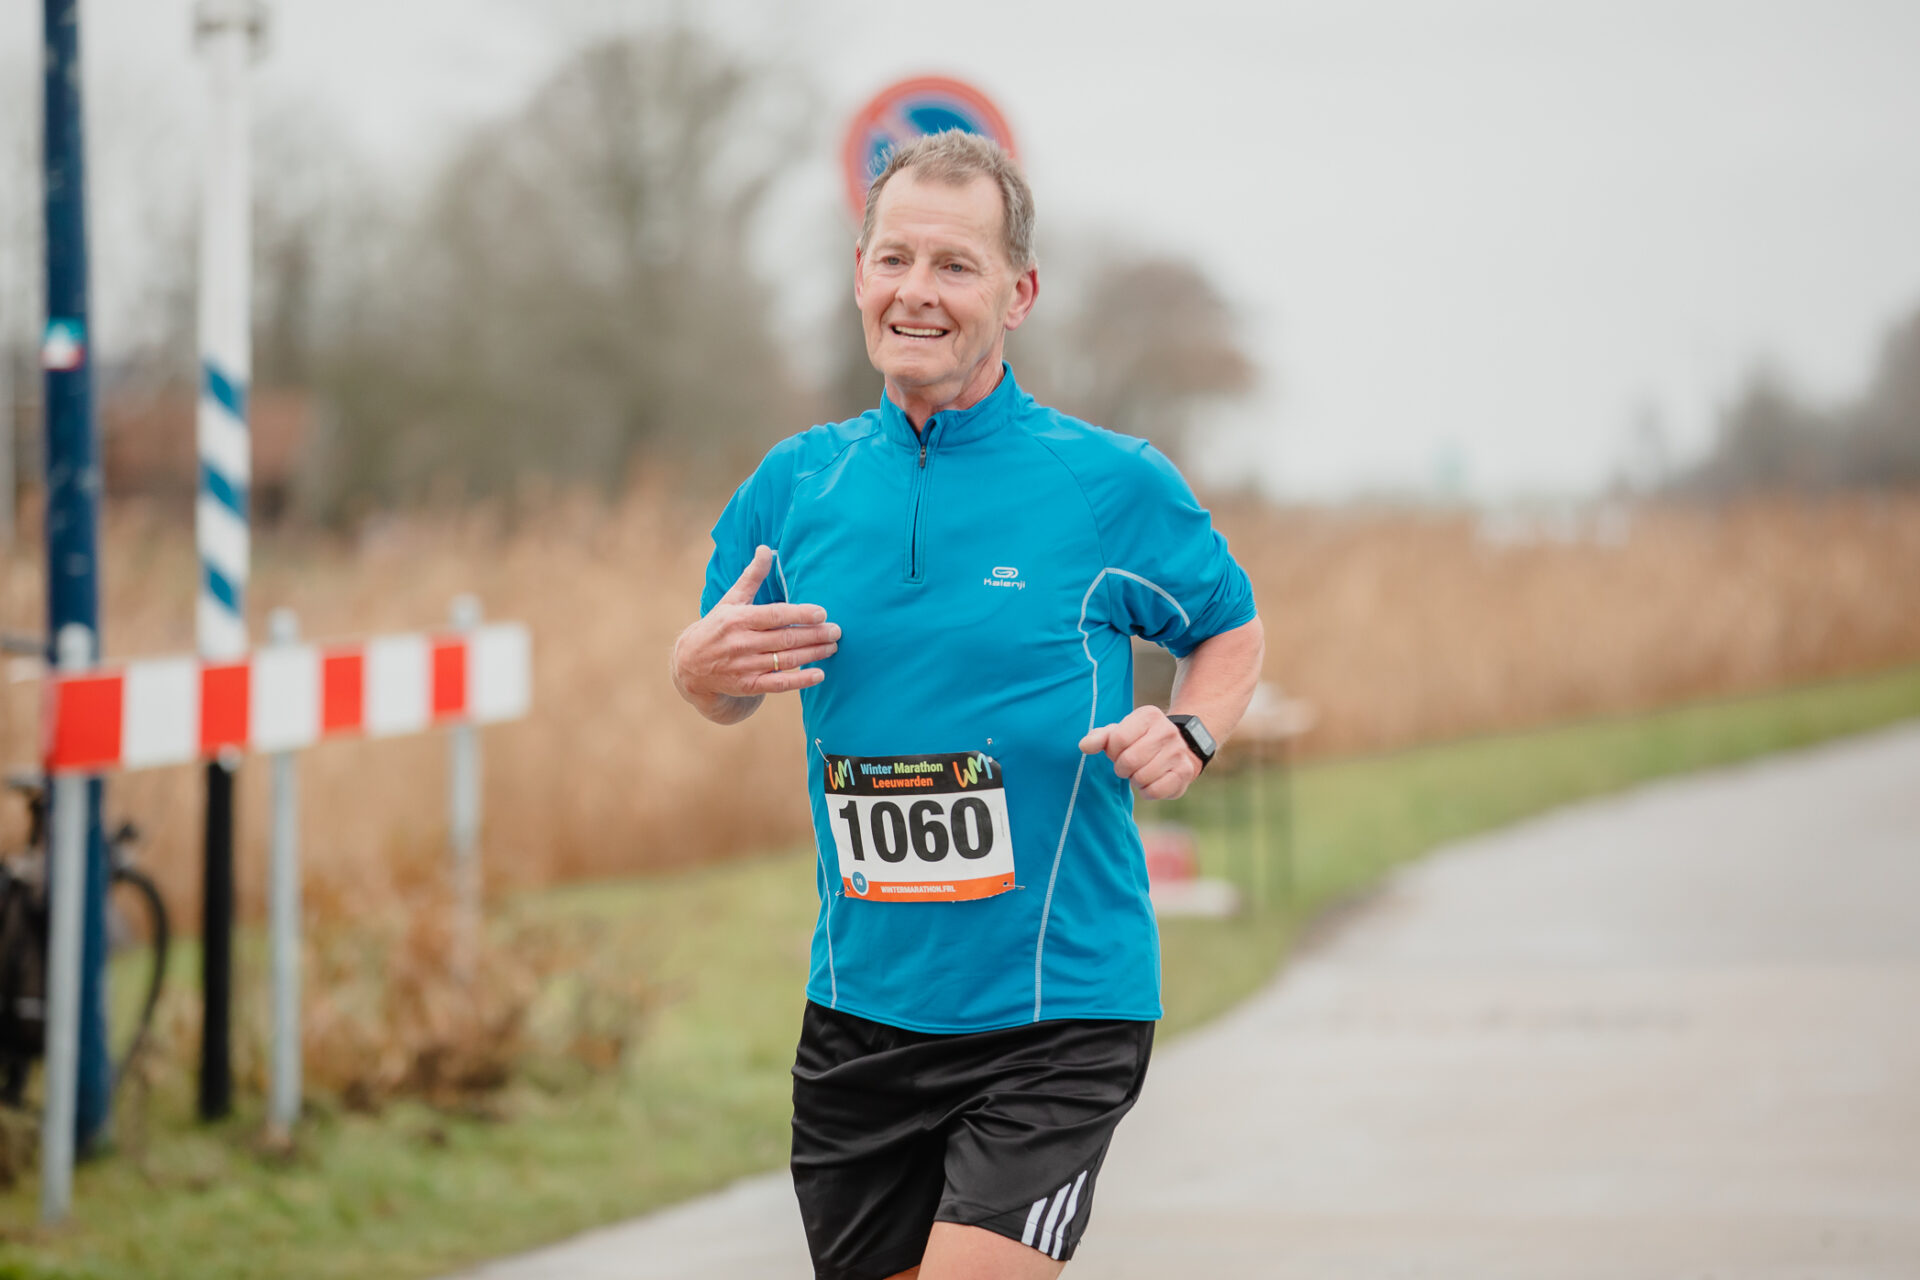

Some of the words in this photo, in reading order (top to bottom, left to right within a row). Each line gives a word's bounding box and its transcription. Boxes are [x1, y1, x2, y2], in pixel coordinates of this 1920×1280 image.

[983, 577, 1026, 591] Kalenji
[860, 763, 892, 775] Winter
[894, 761, 944, 774] Marathon
[872, 775, 934, 789] Leeuwarden
[839, 797, 994, 863] 1060
[880, 885, 956, 894] WINTERMARATHON.FRL
